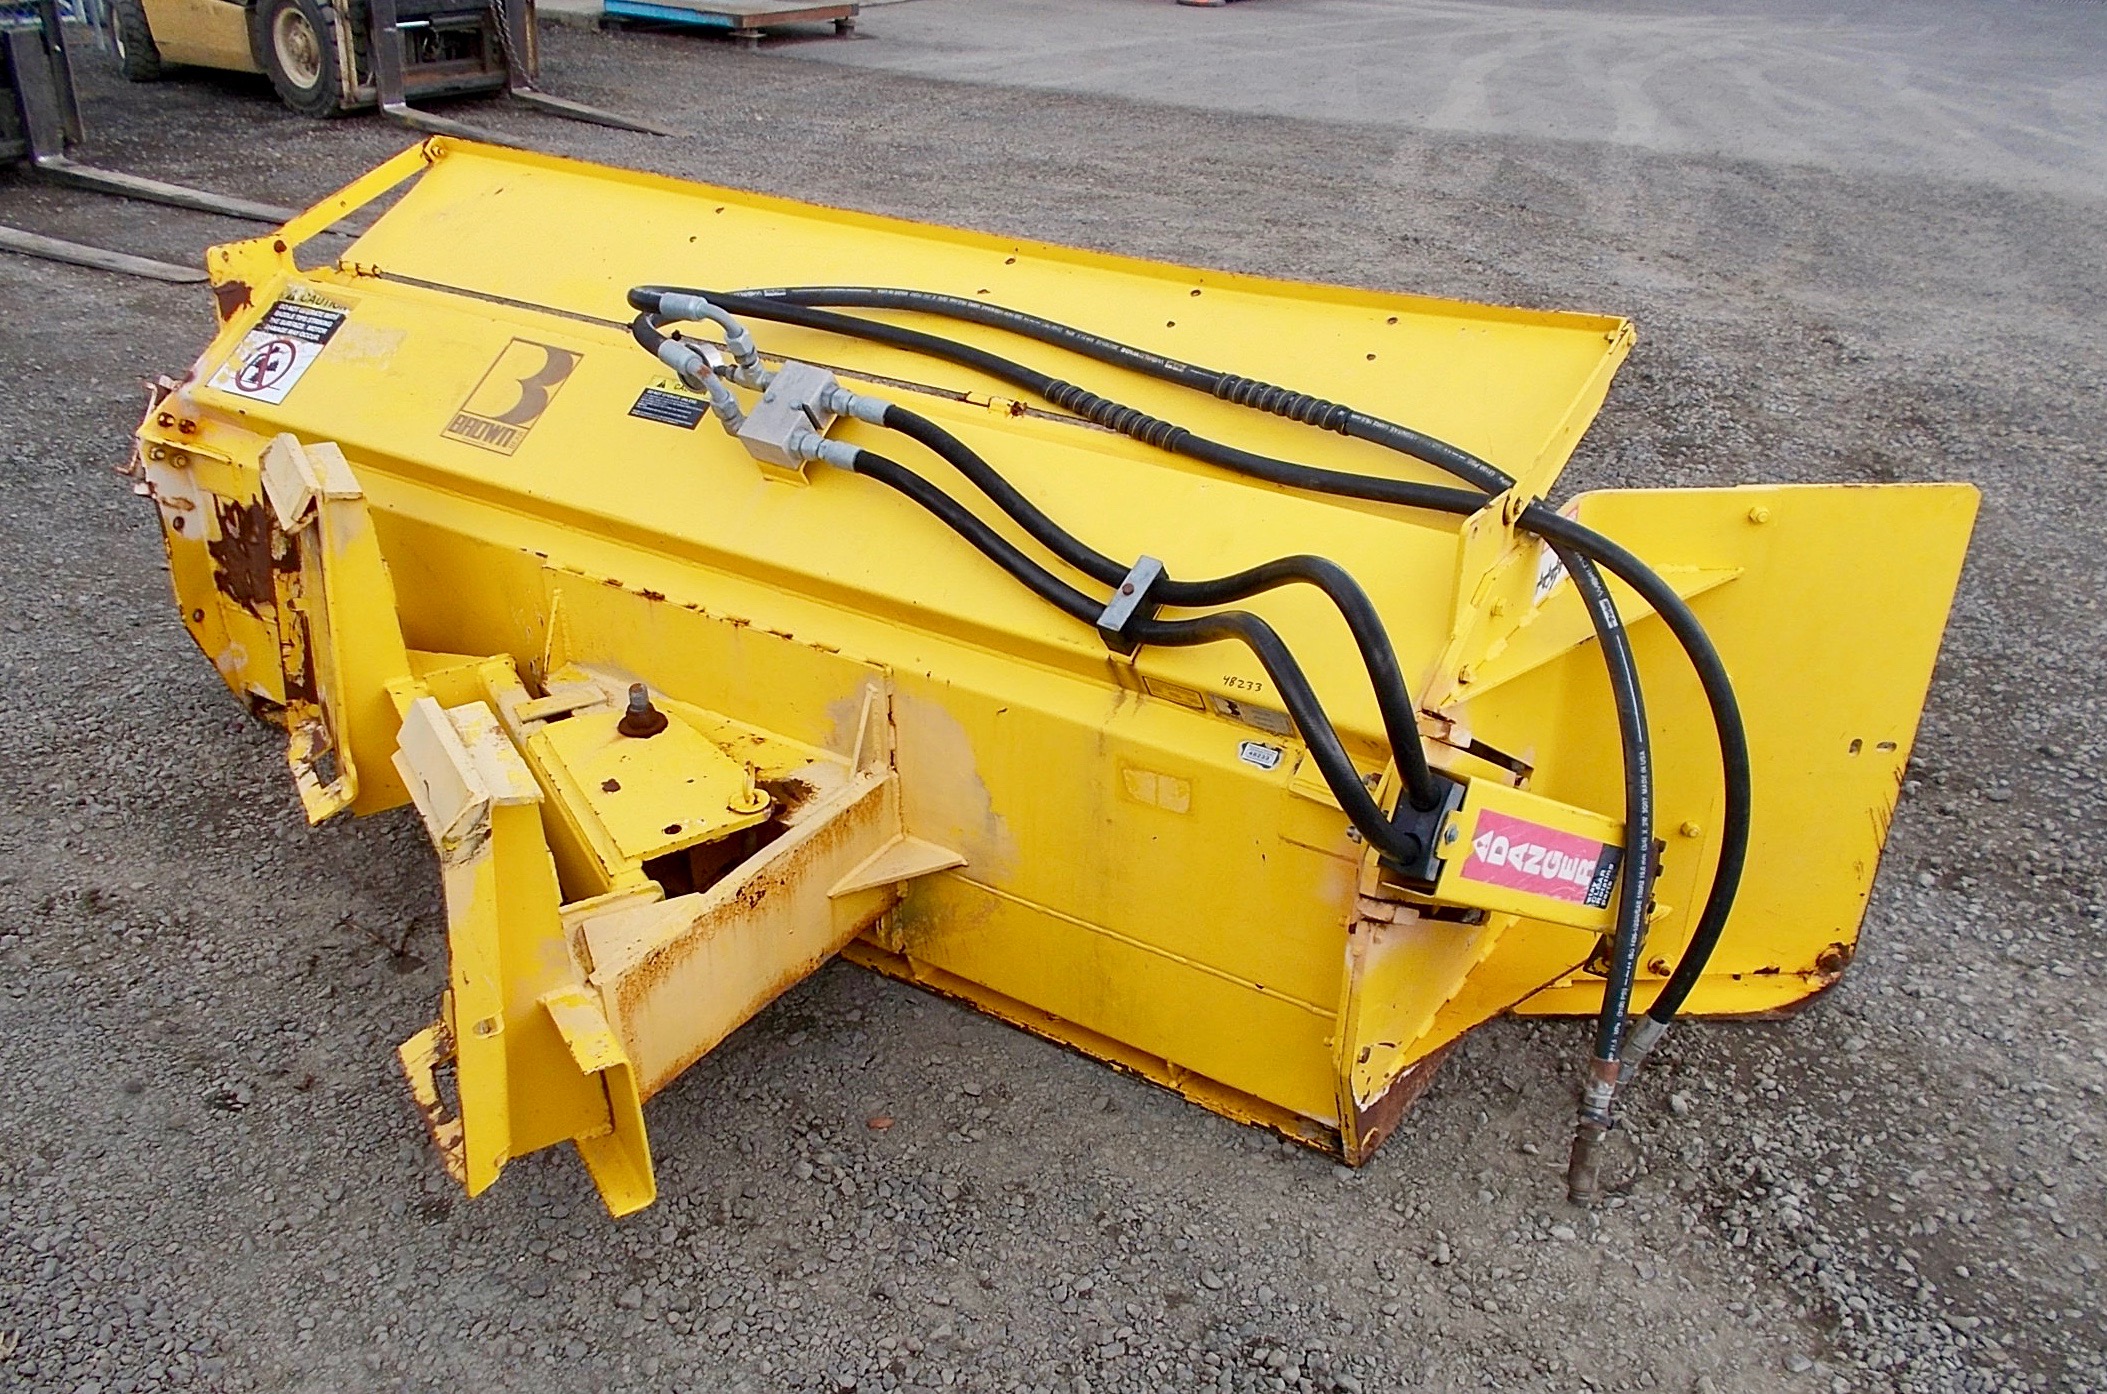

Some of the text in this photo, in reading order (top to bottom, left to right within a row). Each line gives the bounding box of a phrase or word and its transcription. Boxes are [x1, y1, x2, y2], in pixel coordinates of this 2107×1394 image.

[447, 413, 517, 448] BROWN
[1574, 551, 1604, 597] WORLDW
[1223, 675, 1262, 692] 48233
[1487, 835, 1597, 887] DANGER
